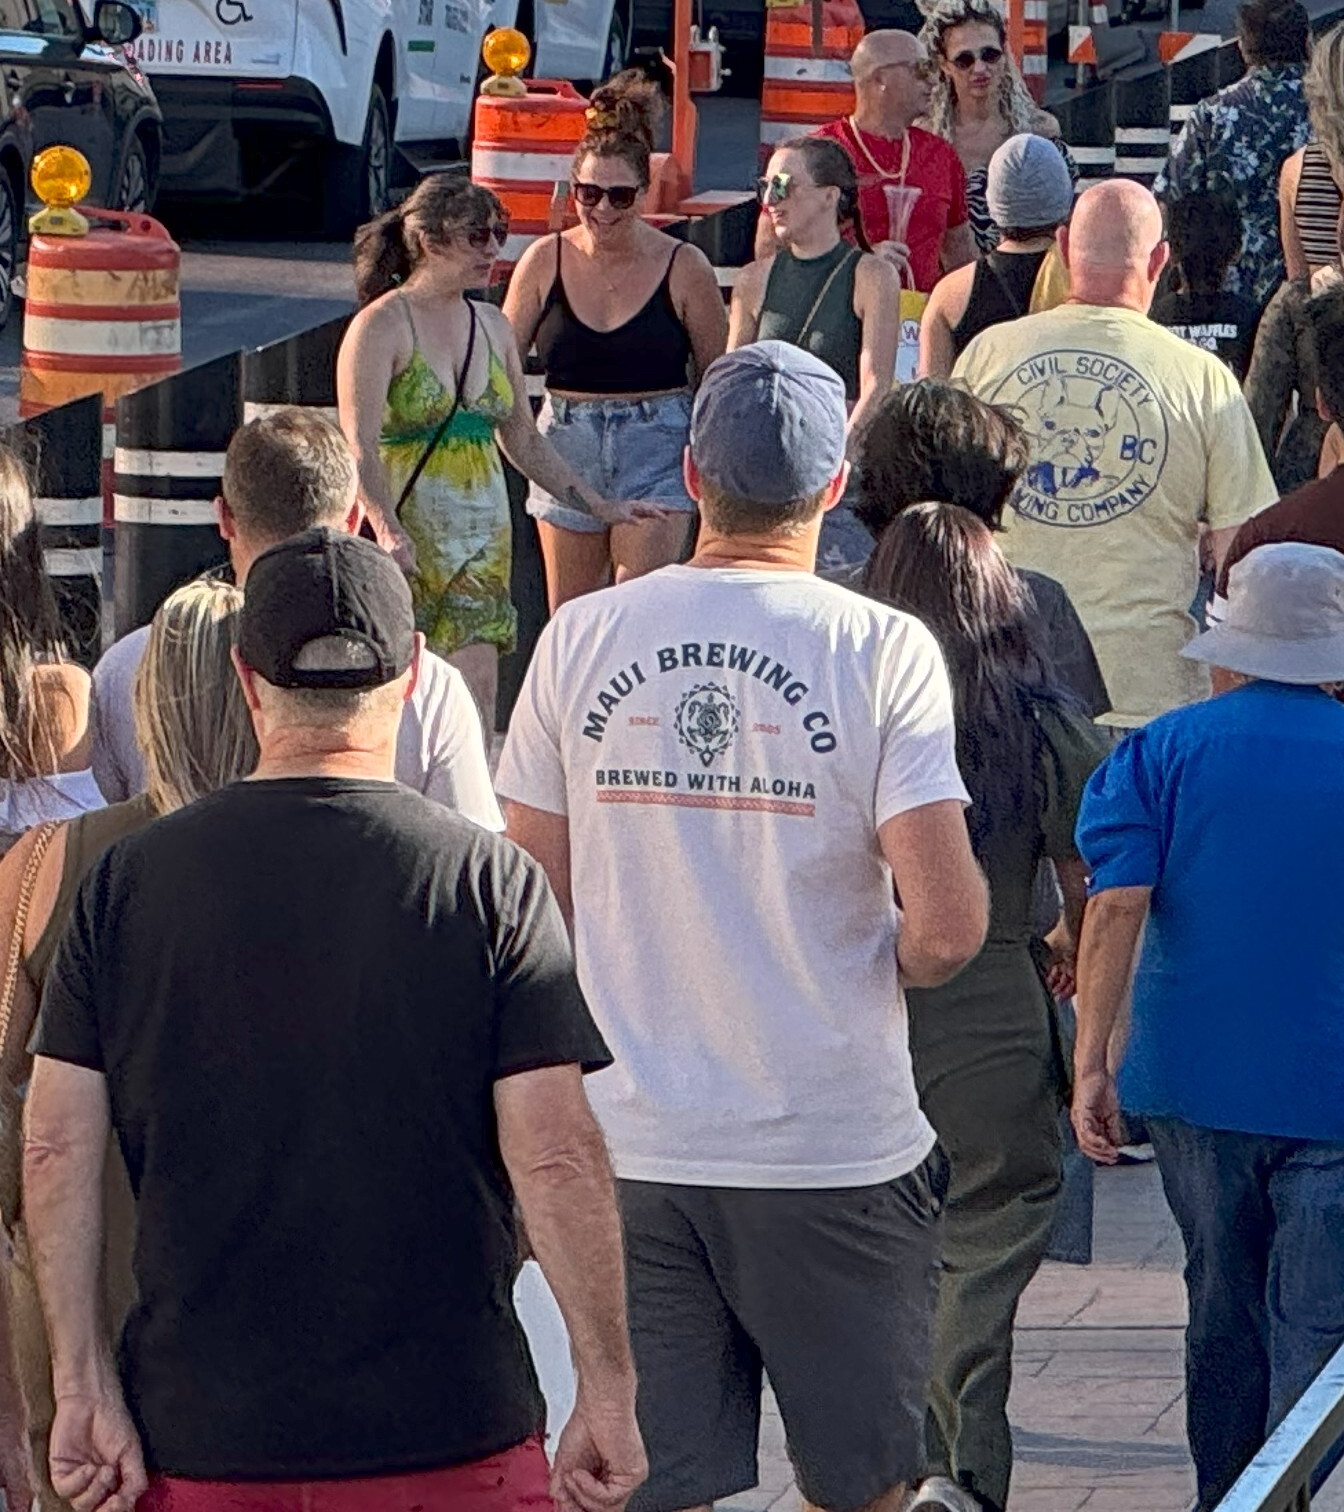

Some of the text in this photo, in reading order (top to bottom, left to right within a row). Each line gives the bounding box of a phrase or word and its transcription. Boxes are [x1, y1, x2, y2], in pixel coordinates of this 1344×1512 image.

[192, 40, 233, 65] AREA
[1016, 355, 1155, 407] CIVIL SOCIETY
[1119, 434, 1158, 466] BC
[1066, 474, 1151, 523] COMPANY
[582, 642, 838, 754] MAUI BREWING CO
[628, 715, 660, 727] SINCE
[595, 769, 817, 800] BREWED WITH ALOHA
